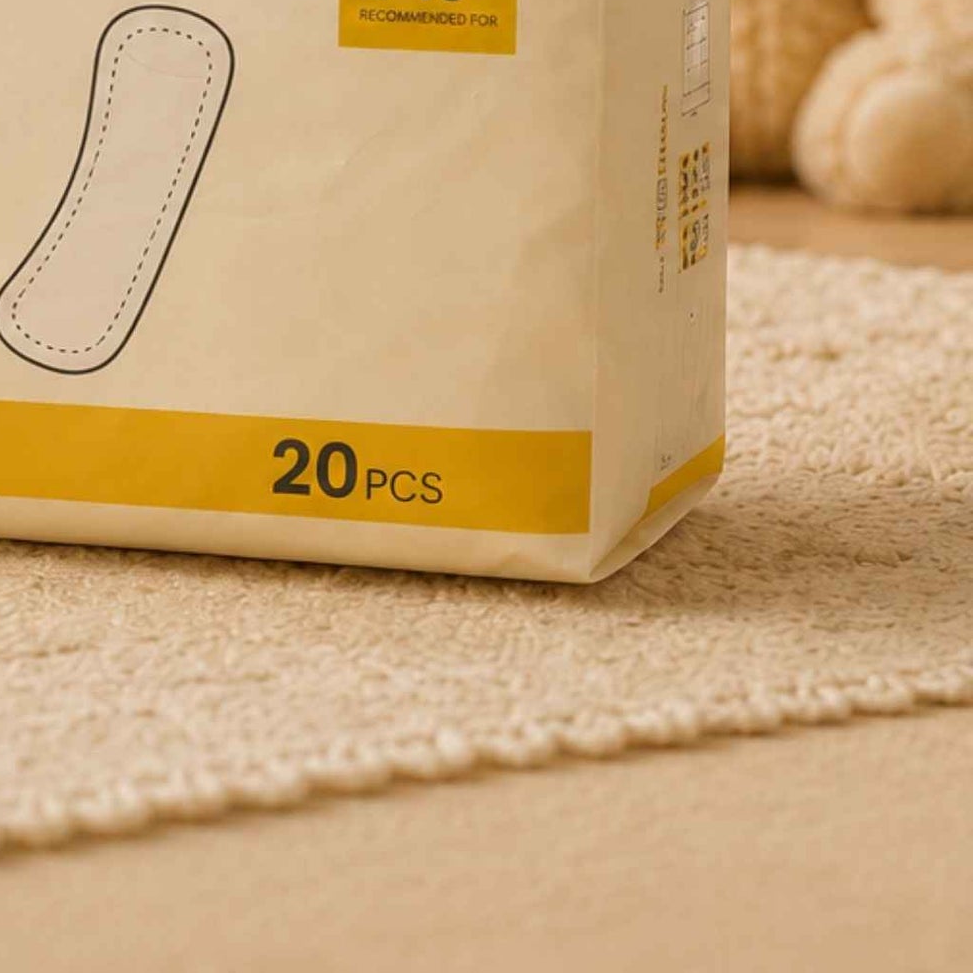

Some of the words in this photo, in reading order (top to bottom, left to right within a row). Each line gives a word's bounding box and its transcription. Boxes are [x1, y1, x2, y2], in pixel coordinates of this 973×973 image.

[360, 9, 466, 25] RECOMMENDED
[470, 13, 498, 27] FOR
[273, 439, 357, 498] 20
[367, 469, 442, 503] PCS
